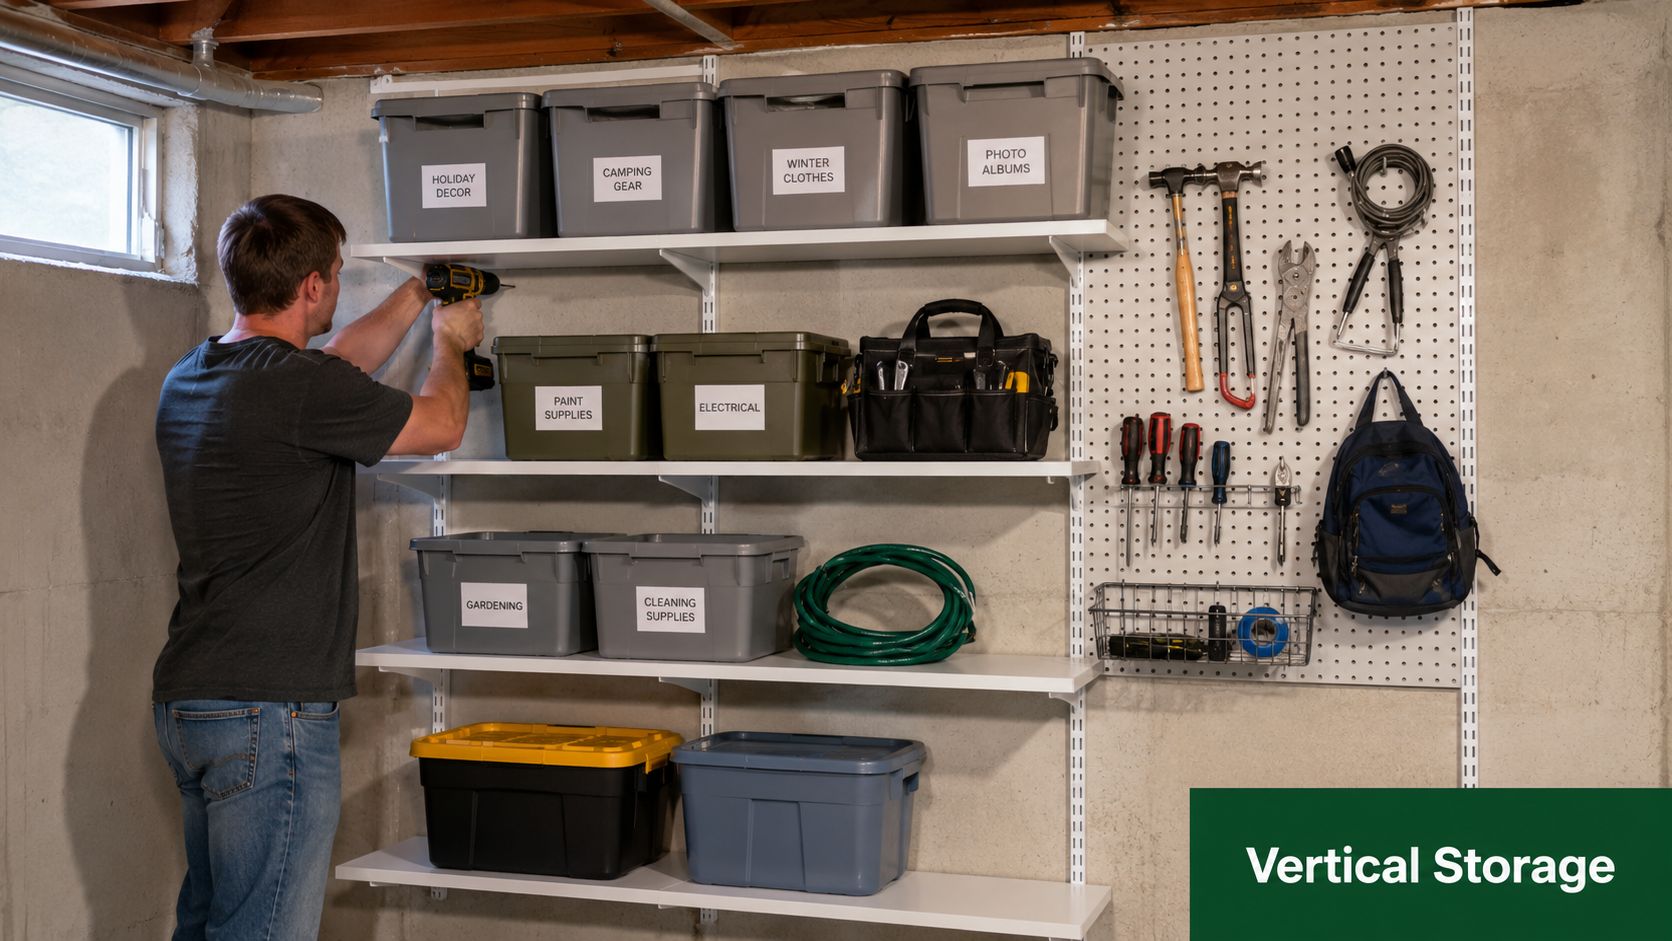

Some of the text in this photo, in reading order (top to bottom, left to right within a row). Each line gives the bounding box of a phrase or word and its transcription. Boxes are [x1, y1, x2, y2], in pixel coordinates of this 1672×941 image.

[986, 149, 1026, 159] PHOTO
[787, 158, 829, 168] WINTER
[603, 167, 651, 177] CAMPING
[983, 164, 1030, 174] ALBUMS
[433, 174, 475, 184] HOLIDAY
[784, 172, 833, 183] CLOTHES
[614, 181, 642, 191] GEAR
[437, 188, 471, 197] DECOR
[554, 396, 583, 406] PAINT
[699, 402, 761, 413] ELECTRICAL
[544, 409, 593, 420] SUPPLIES
[467, 600, 523, 610] GARDENING
[644, 597, 696, 608] CLEANING
[647, 611, 695, 622] SUPPLIES
